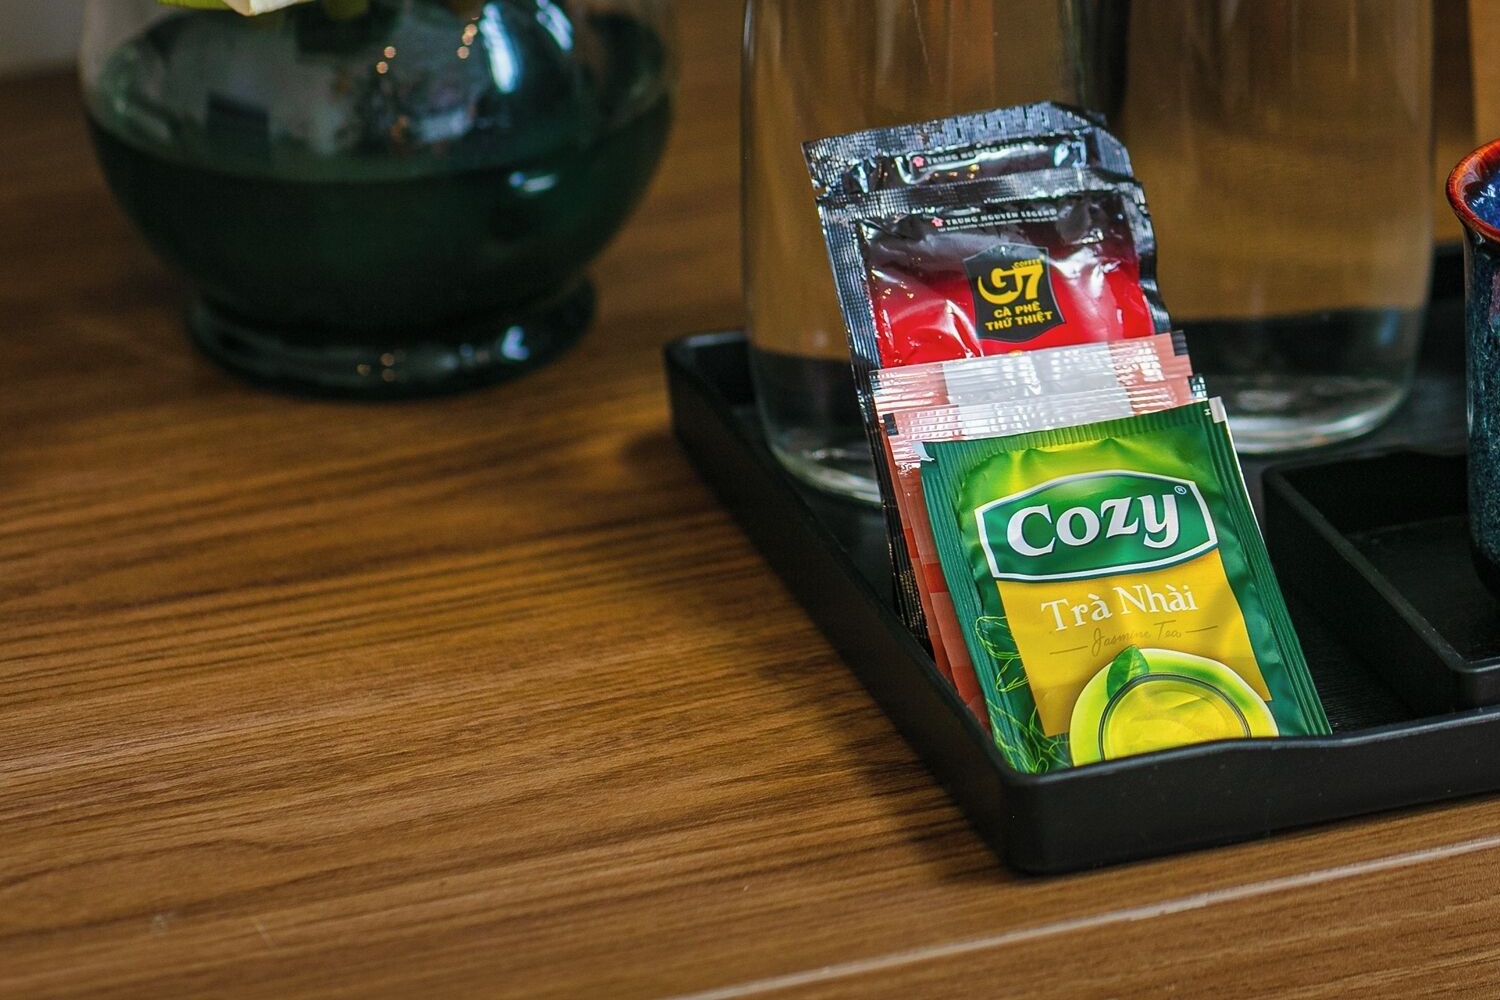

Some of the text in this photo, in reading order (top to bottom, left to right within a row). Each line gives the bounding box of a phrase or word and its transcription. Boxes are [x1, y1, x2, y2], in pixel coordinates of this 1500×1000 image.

[945, 216, 978, 226] TRUNG
[1021, 207, 1058, 218] LEGEND
[977, 264, 1044, 305] G7
[993, 301, 1041, 318] CÀ PHÊ
[1015, 310, 1053, 325] THIỆT
[1006, 494, 1180, 557] Cozy
[1040, 583, 1199, 632] Trà Nhài
[1091, 619, 1182, 657] Jasmine Tea
